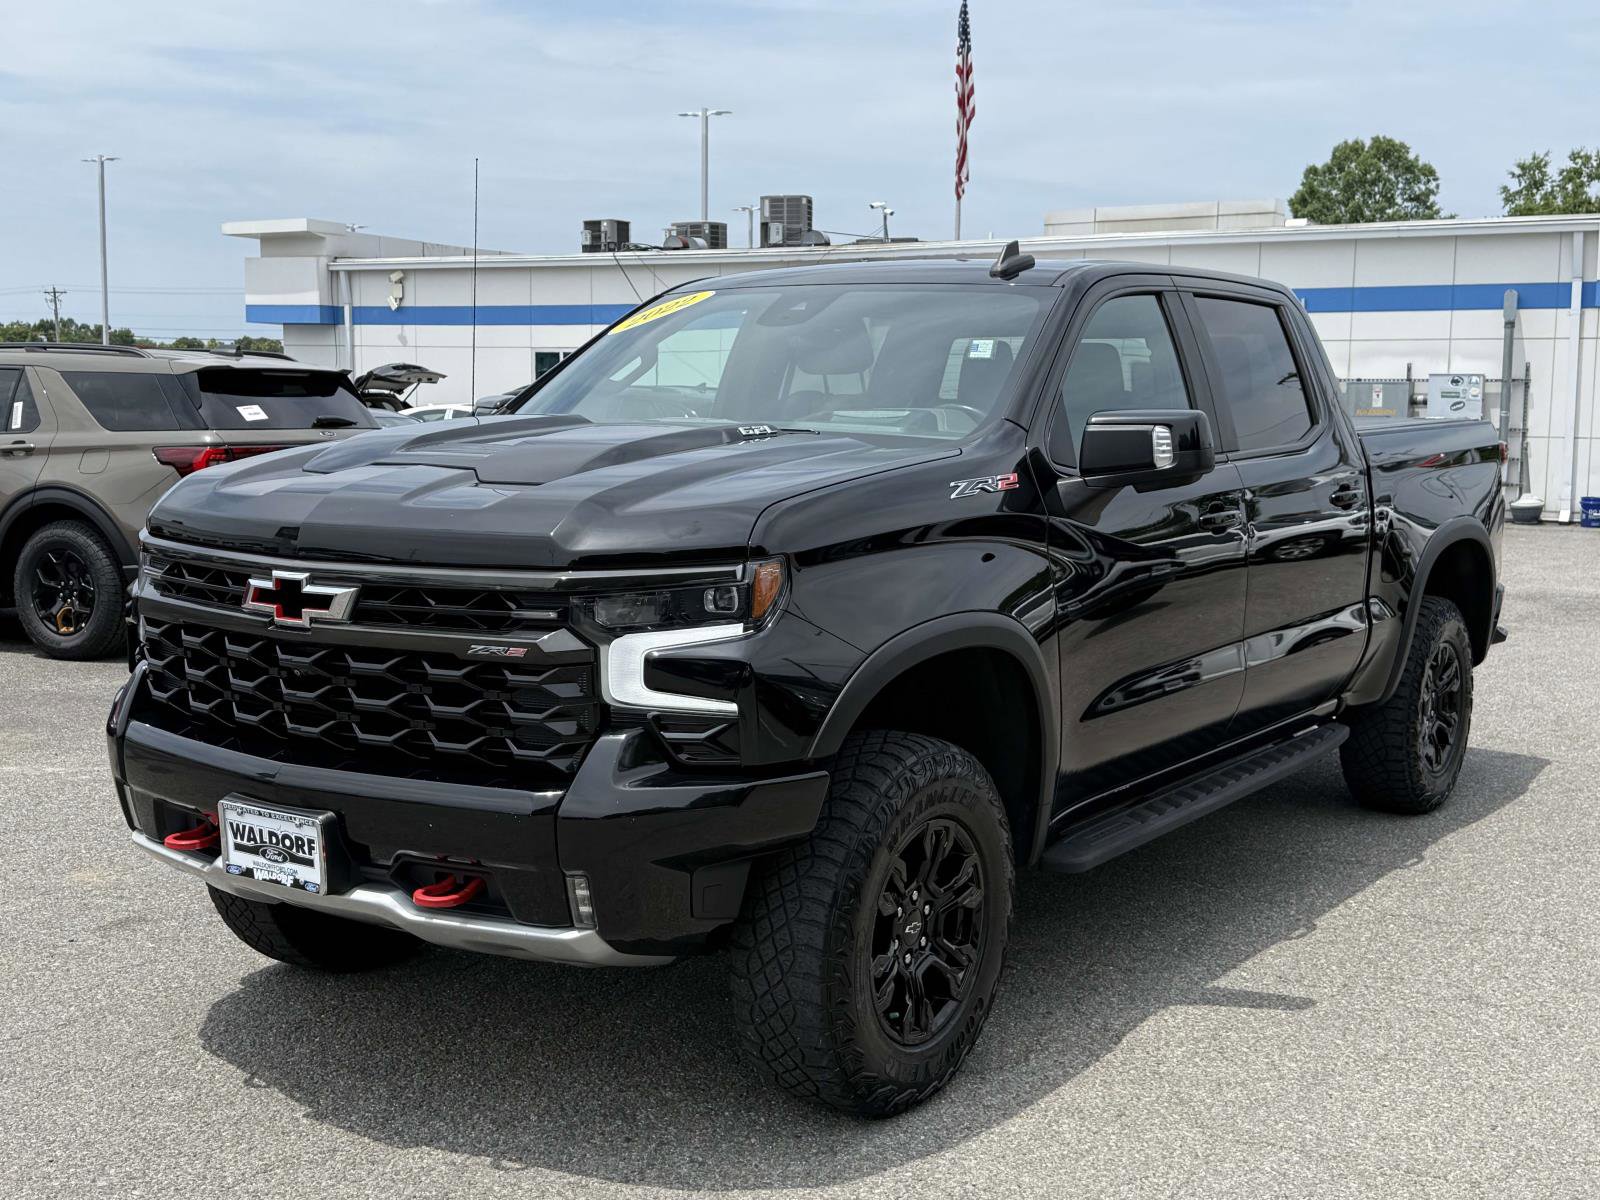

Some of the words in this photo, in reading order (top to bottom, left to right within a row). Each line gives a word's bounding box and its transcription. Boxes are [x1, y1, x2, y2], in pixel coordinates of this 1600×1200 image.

[949, 472, 1020, 500] ZR2
[466, 644, 528, 658] ZR2
[261, 810, 270, 818] TO
[228, 820, 317, 857] WALDORF
[264, 848, 284, 863] Ford
[252, 867, 295, 887] WALDORF
